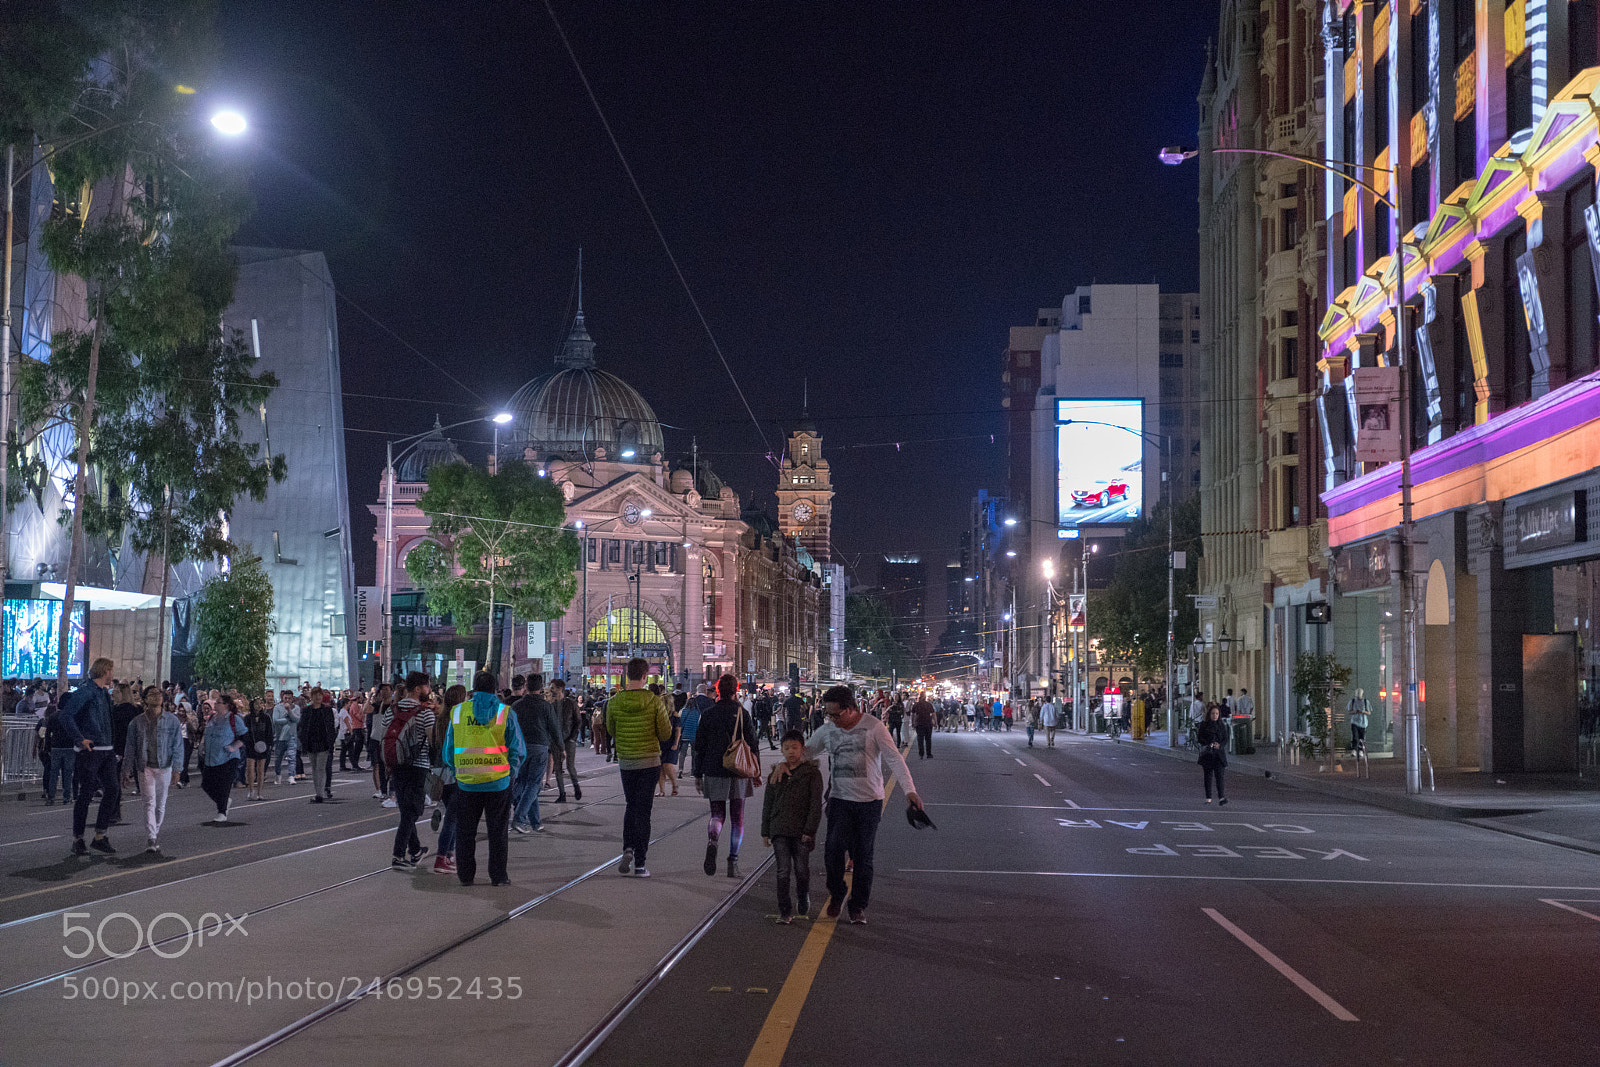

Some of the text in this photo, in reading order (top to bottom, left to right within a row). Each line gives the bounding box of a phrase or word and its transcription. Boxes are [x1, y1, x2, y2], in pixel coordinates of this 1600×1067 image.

[358, 590, 367, 636] MUSEUM
[398, 614, 443, 627] CENTRE
[1055, 817, 1316, 834] CLEAR
[1125, 843, 1370, 862] KEEP
